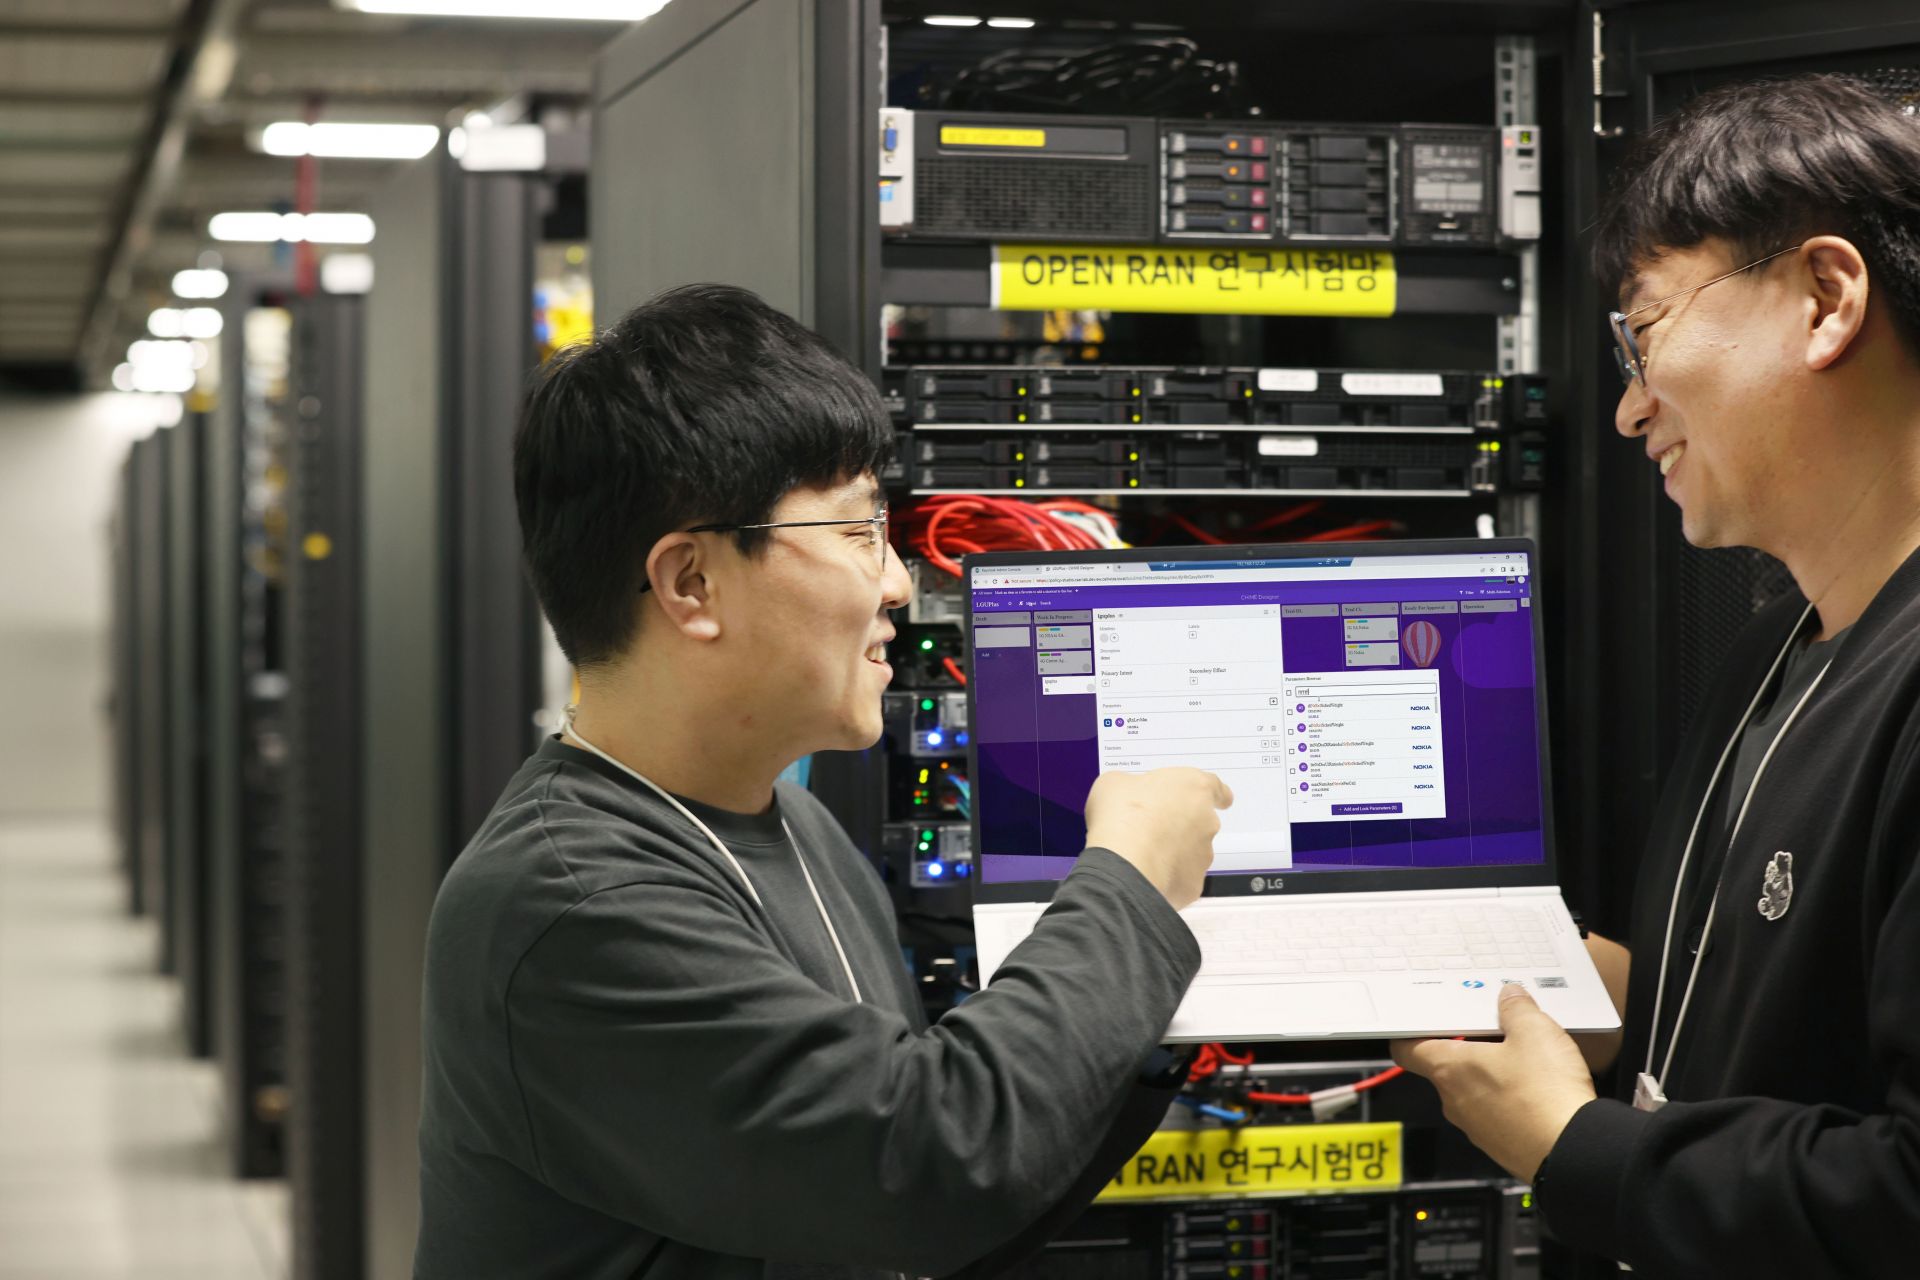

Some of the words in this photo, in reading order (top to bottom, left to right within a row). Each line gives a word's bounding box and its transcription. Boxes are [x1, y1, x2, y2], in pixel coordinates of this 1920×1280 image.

[1022, 254, 1114, 286] OPEN
[1127, 254, 1196, 286] RAN
[1208, 250, 1382, 291] 연구시험망
[1189, 667, 1212, 675] Secondary
[1266, 878, 1284, 890] LG
[1136, 1153, 1206, 1186] RAN
[1218, 1139, 1389, 1186] 연구시험망
